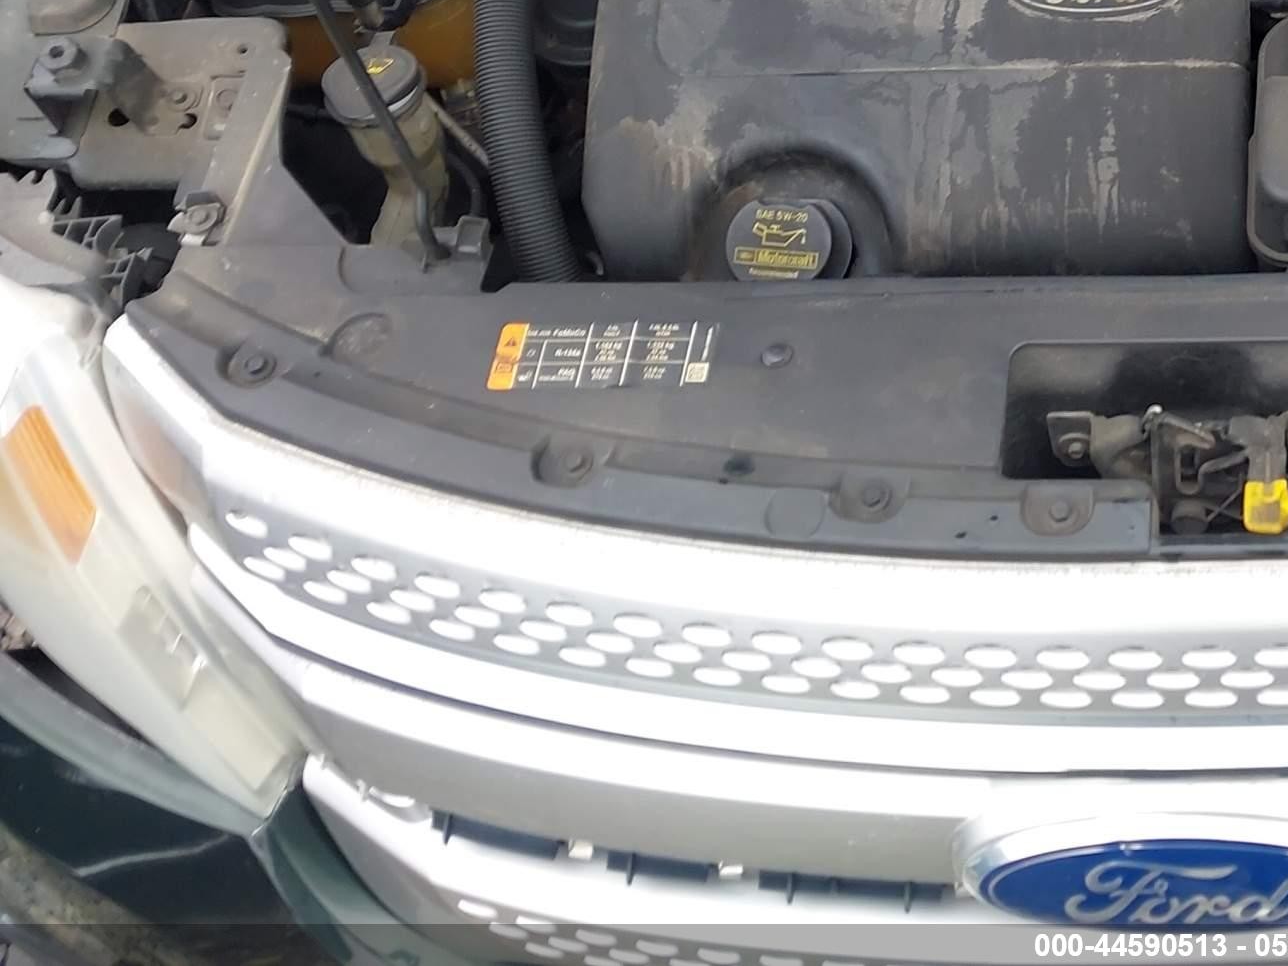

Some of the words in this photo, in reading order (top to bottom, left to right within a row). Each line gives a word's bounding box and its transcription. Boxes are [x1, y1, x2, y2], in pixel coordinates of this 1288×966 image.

[755, 209, 775, 220] SAE
[775, 210, 809, 223] 5W-20
[757, 250, 813, 267] Motorcraft
